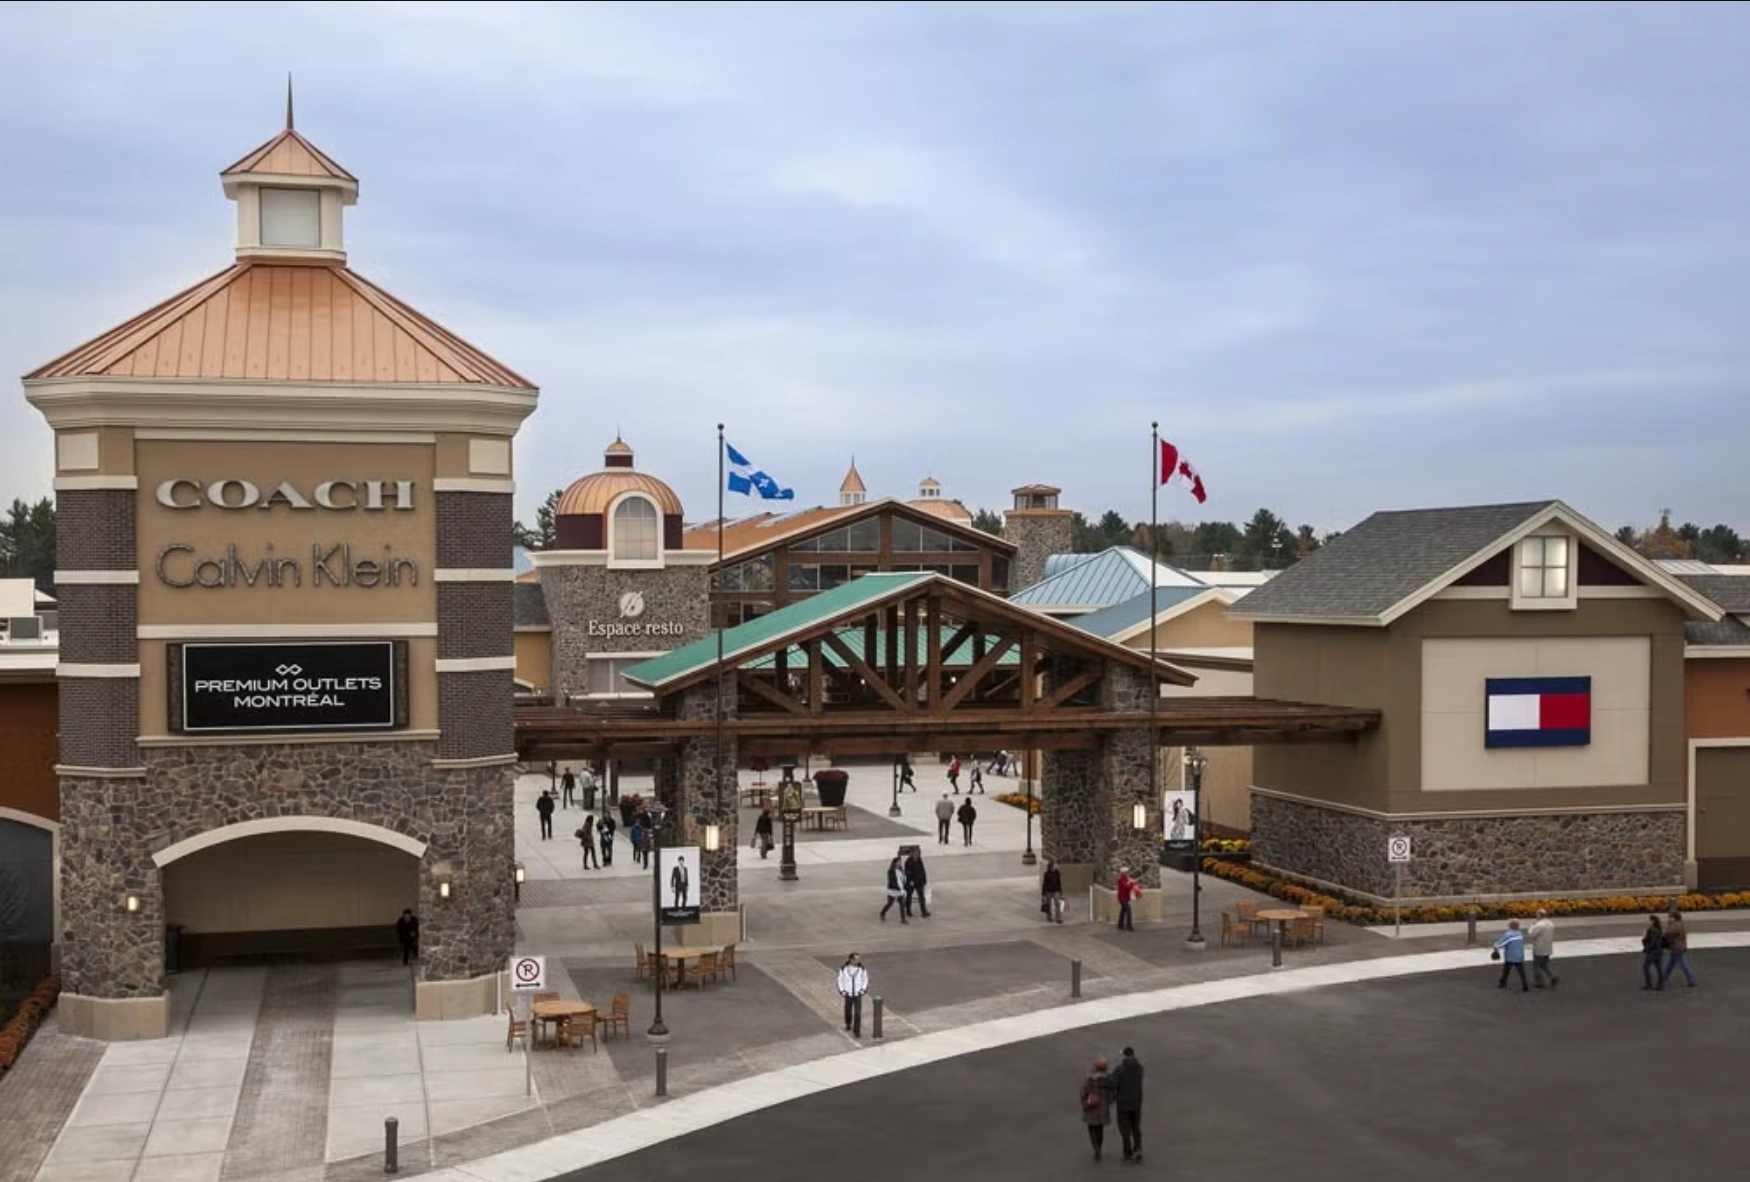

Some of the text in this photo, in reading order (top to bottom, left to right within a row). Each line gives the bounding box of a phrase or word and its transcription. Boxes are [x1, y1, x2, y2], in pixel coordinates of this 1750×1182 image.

[155, 479, 414, 510] COACH
[156, 542, 418, 588] Calvin Klein
[589, 620, 683, 639] Espace resto
[195, 677, 382, 692] PREMIUM OUTLETS
[234, 692, 345, 708] MONTRÉAL
